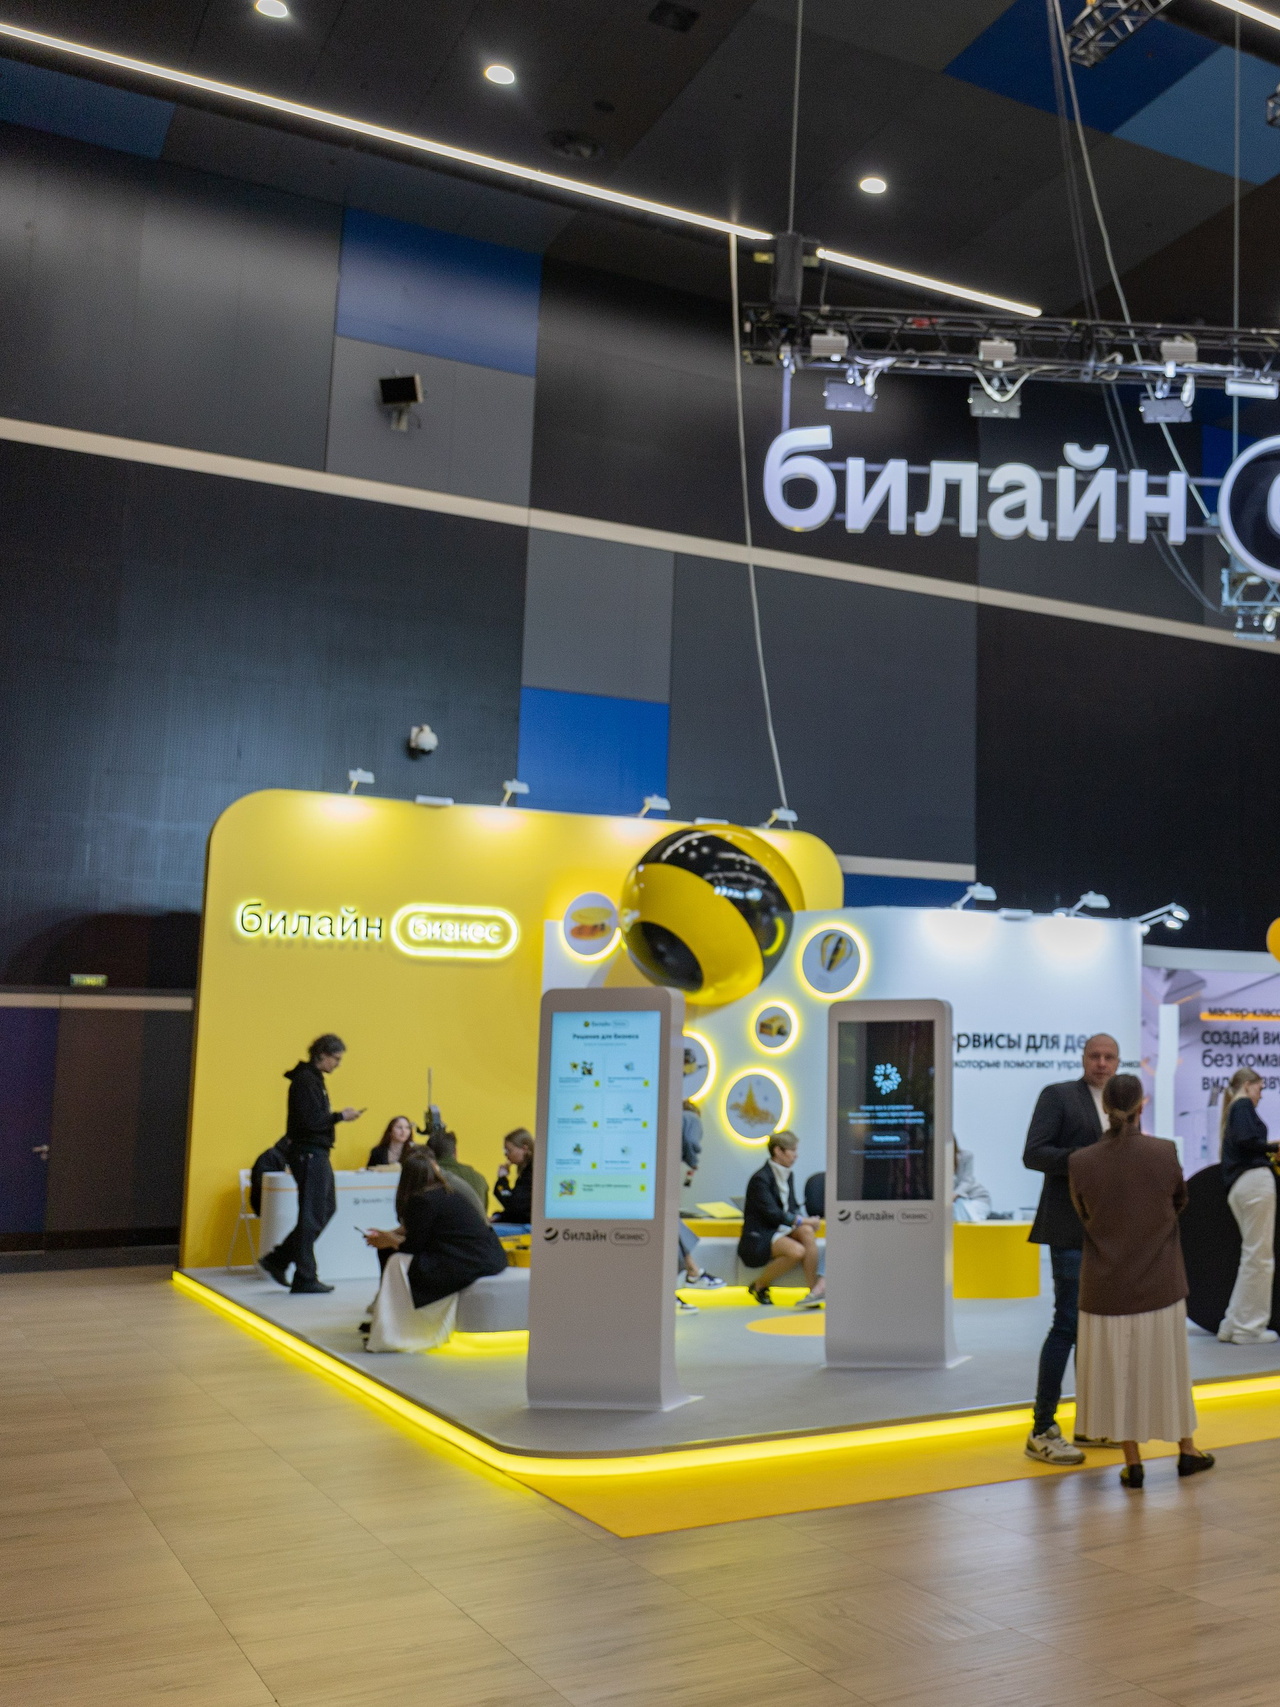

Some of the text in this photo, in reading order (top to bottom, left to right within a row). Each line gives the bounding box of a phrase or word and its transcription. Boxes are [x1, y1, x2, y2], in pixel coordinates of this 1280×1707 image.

[763, 425, 1188, 546] билайн
[236, 900, 503, 944] билайн бизнес
[953, 1033, 1088, 1053] рвисы для де
[1201, 1026, 1259, 1048] создай
[1202, 1048, 1234, 1068] без
[855, 1210, 894, 1221] билайн
[562, 1228, 607, 1242] билайн
